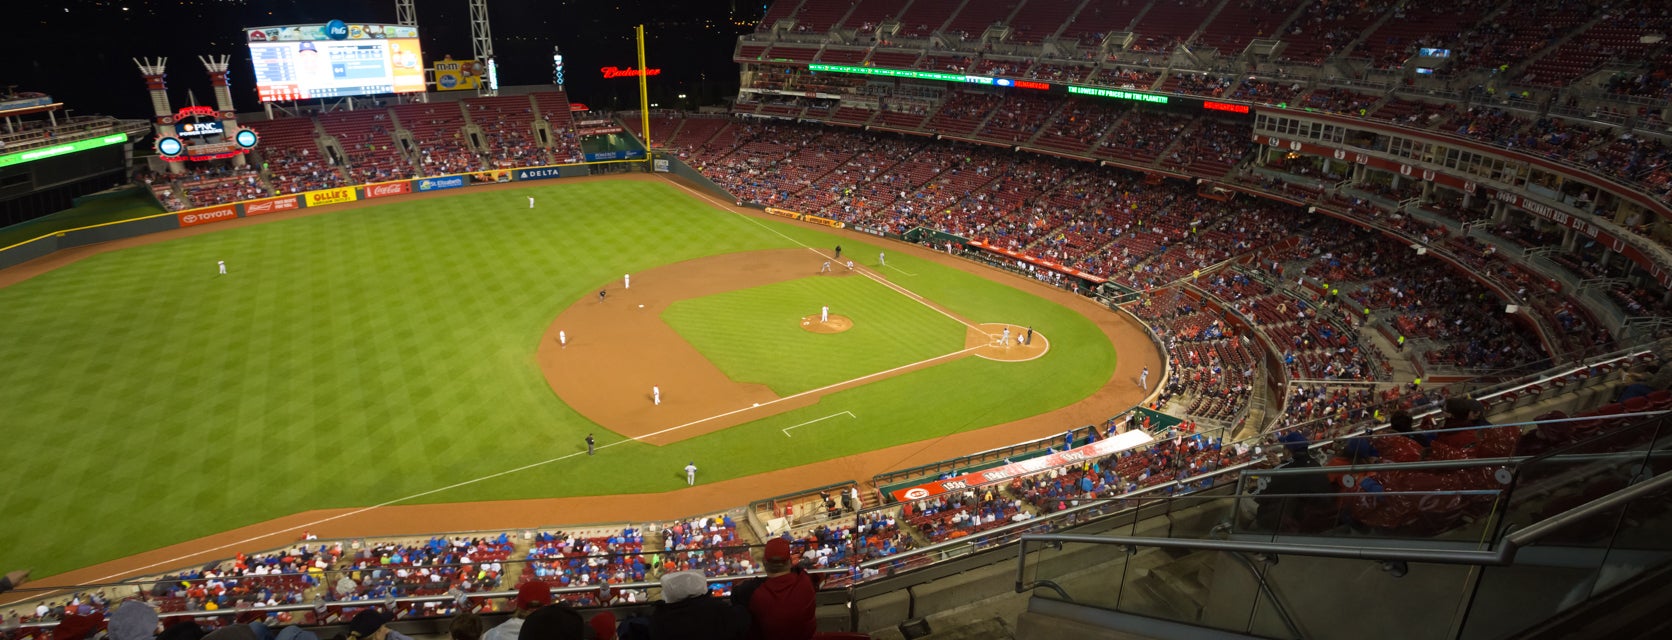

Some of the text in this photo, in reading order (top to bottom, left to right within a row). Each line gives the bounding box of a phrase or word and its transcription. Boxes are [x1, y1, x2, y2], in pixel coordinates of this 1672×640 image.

[600, 66, 661, 79] Budweser
[1078, 87, 1097, 96] LOWEST
[1106, 90, 1123, 98] PRICES
[1133, 93, 1142, 101] THE
[194, 122, 216, 132] PNC
[529, 168, 559, 178] DELTA
[374, 184, 401, 195] Coca-Cola
[313, 190, 349, 202] OLLIE'S
[197, 209, 234, 220] TOYOTA
[1522, 198, 1553, 219] CINCINNATI
[1553, 209, 1569, 225] REDS
[1572, 217, 1588, 233] EST.
[943, 481, 966, 491] 1939
